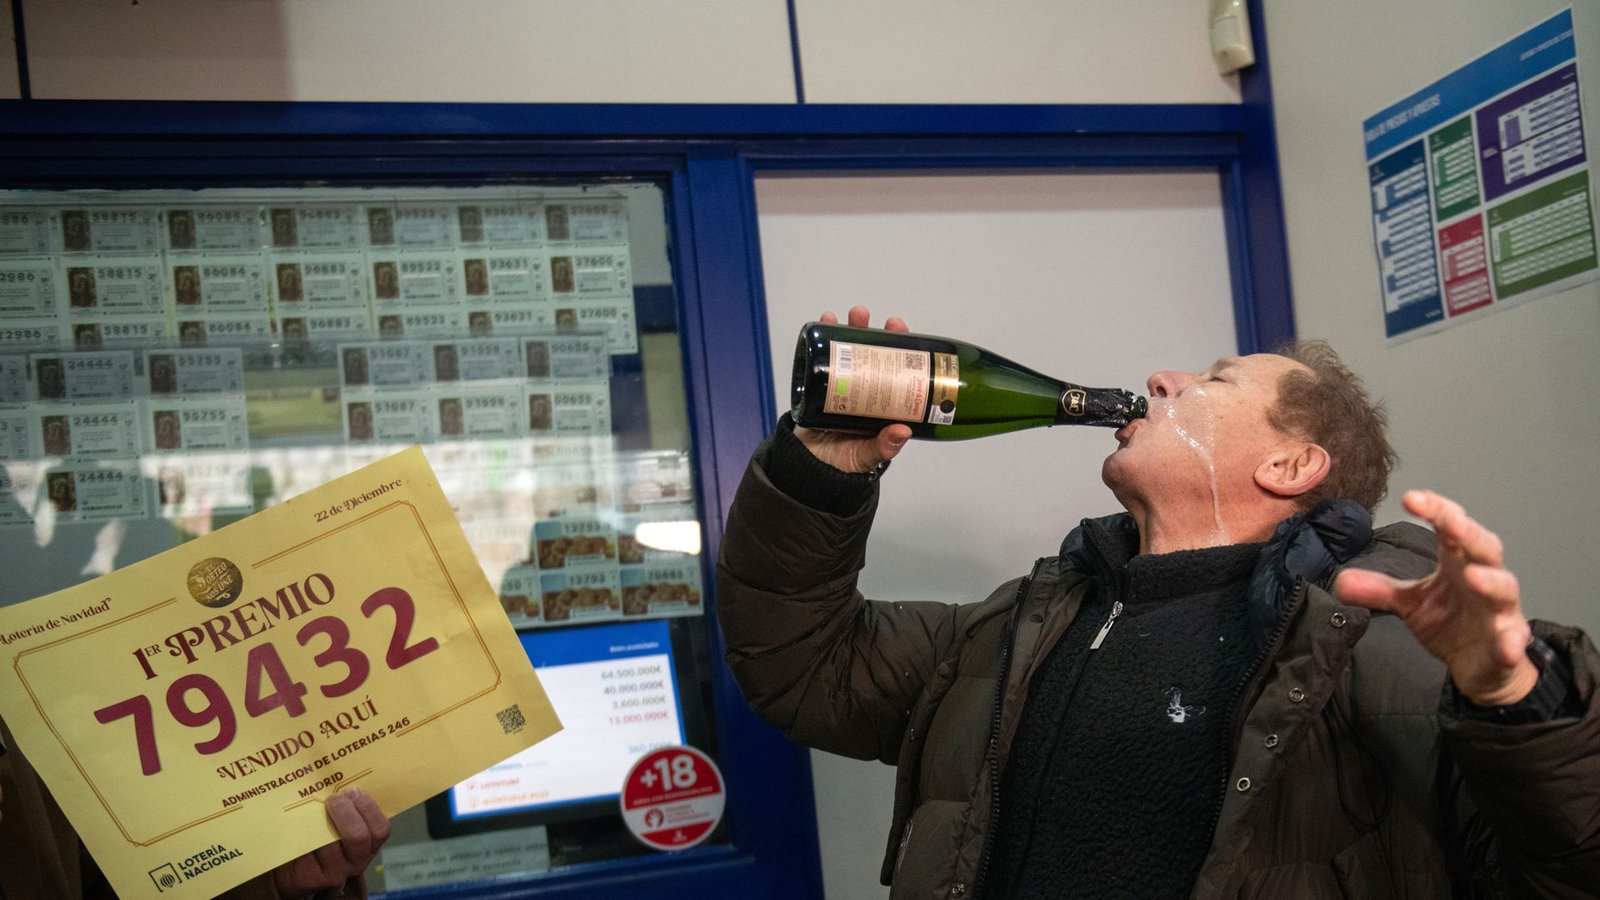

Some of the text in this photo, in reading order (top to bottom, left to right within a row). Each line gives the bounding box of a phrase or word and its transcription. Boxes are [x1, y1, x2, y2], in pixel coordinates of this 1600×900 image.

[314, 478, 403, 523] 22 de Diciembre
[46, 620, 60, 631] de
[60, 597, 112, 626] Navidad
[164, 572, 336, 665] PREMIO
[93, 586, 440, 777] 79432
[216, 695, 379, 781] VENDIDO AQUÍ
[222, 717, 411, 809] ADMINISTRACION DE LOTERIAS 246
[640, 753, 698, 792] +18
[298, 771, 344, 799] MADRID
[178, 844, 227, 870] LOTERÍA
[184, 849, 244, 880] NACIONAL
